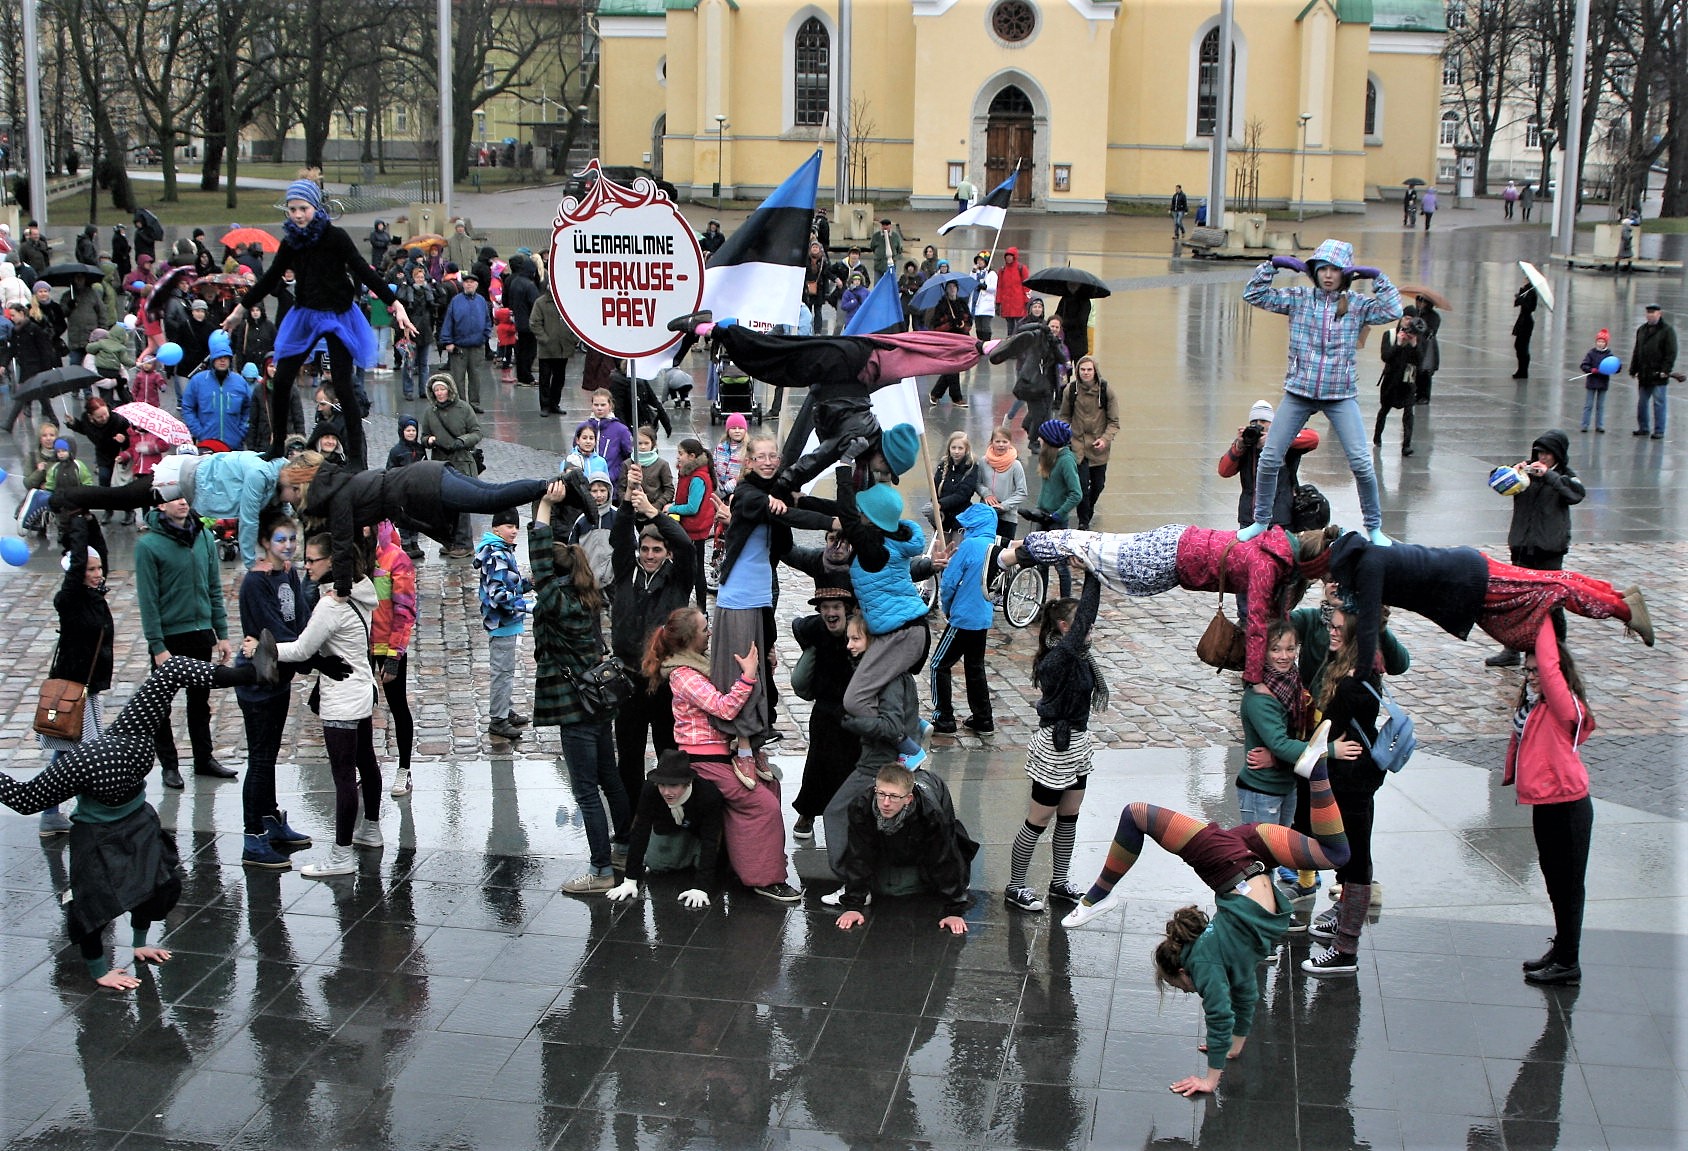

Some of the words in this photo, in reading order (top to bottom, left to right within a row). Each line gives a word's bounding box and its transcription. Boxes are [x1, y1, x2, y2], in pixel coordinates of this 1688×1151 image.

[573, 230, 674, 255] ÜLEMAAILMNE
[575, 261, 689, 291] TSIRKUSE-
[601, 291, 657, 327] PÄEV
